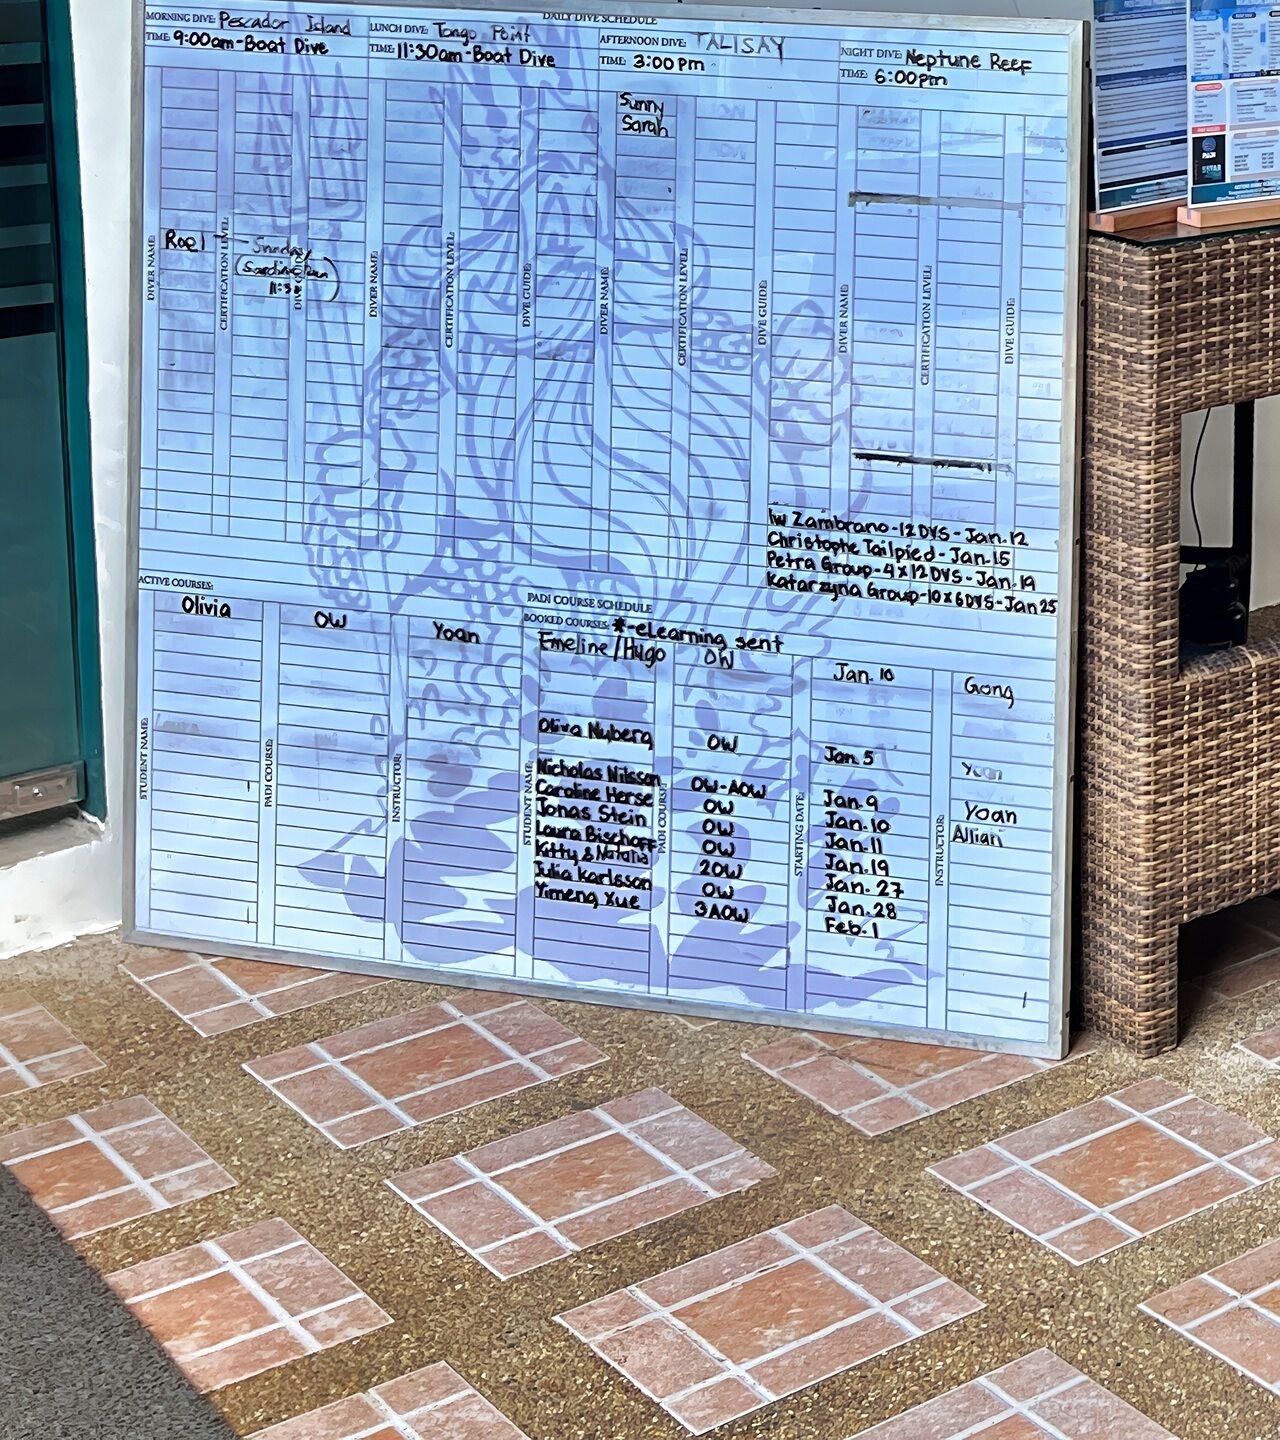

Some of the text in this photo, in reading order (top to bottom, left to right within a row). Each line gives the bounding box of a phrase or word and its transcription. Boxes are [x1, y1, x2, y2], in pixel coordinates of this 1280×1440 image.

[146, 12, 215, 23] MORNING DIVE:
[219, 11, 351, 35] Pescador Island
[369, 23, 428, 34] LUNCH DIVE:
[433, 22, 530, 46] Tango Point
[600, 35, 686, 47] AFTERNOON DIVE:
[295, 38, 329, 55] Dive
[691, 32, 785, 63] TALISAY
[841, 47, 902, 59] NIGHT DIVE:
[520, 49, 555, 67] Dive
[906, 49, 981, 71] Neptune
[620, 92, 664, 118] Sunny
[622, 115, 668, 137] Sarah
[147, 270, 155, 301] DIVER
[220, 252, 229, 330] CERTIFICATION
[369, 284, 378, 317] DIVER
[445, 269, 454, 348] CERTIFICATION
[522, 300, 531, 327] DIVE
[600, 302, 608, 335] DIVER
[678, 287, 687, 366] CERTIFICATION
[758, 318, 767, 345] DIVE
[839, 320, 848, 354] DIVER
[921, 303, 930, 385] CERTIFICATION
[1005, 336, 1014, 365] DIVE
[768, 531, 860, 557] Christophe
[863, 539, 936, 563] Tailpied
[767, 550, 816, 570] Petra
[139, 576, 170, 587] ACTIVE
[767, 571, 862, 602] Katarzyna
[181, 595, 232, 619] Olivia
[527, 593, 653, 613] PADI COURSE SCHEDULE
[524, 613, 563, 624] BOOKED
[432, 621, 481, 645] Yoan
[735, 635, 784, 653] sent
[704, 649, 734, 669] OW
[880, 667, 895, 682] 10
[707, 734, 739, 753] OW
[537, 758, 603, 780] Nicholas
[863, 750, 874, 766] 5
[140, 751, 148, 799] STUDENT
[263, 783, 273, 807] PADI
[535, 778, 600, 801] Caroline
[536, 796, 647, 826] Jonas Stein
[867, 795, 879, 812] 9
[965, 800, 1017, 824] Yoan
[524, 796, 533, 845] STUDENT
[536, 819, 582, 841] Laura
[871, 818, 890, 834] 10
[536, 839, 578, 866] Kitty
[582, 846, 594, 862] &
[794, 827, 804, 877] STARTING
[533, 860, 573, 882] Julia
[871, 859, 889, 877] 19
[876, 879, 904, 898] 27
[605, 891, 640, 909] Xue
[873, 902, 897, 919] 28
[871, 923, 879, 938] 1
